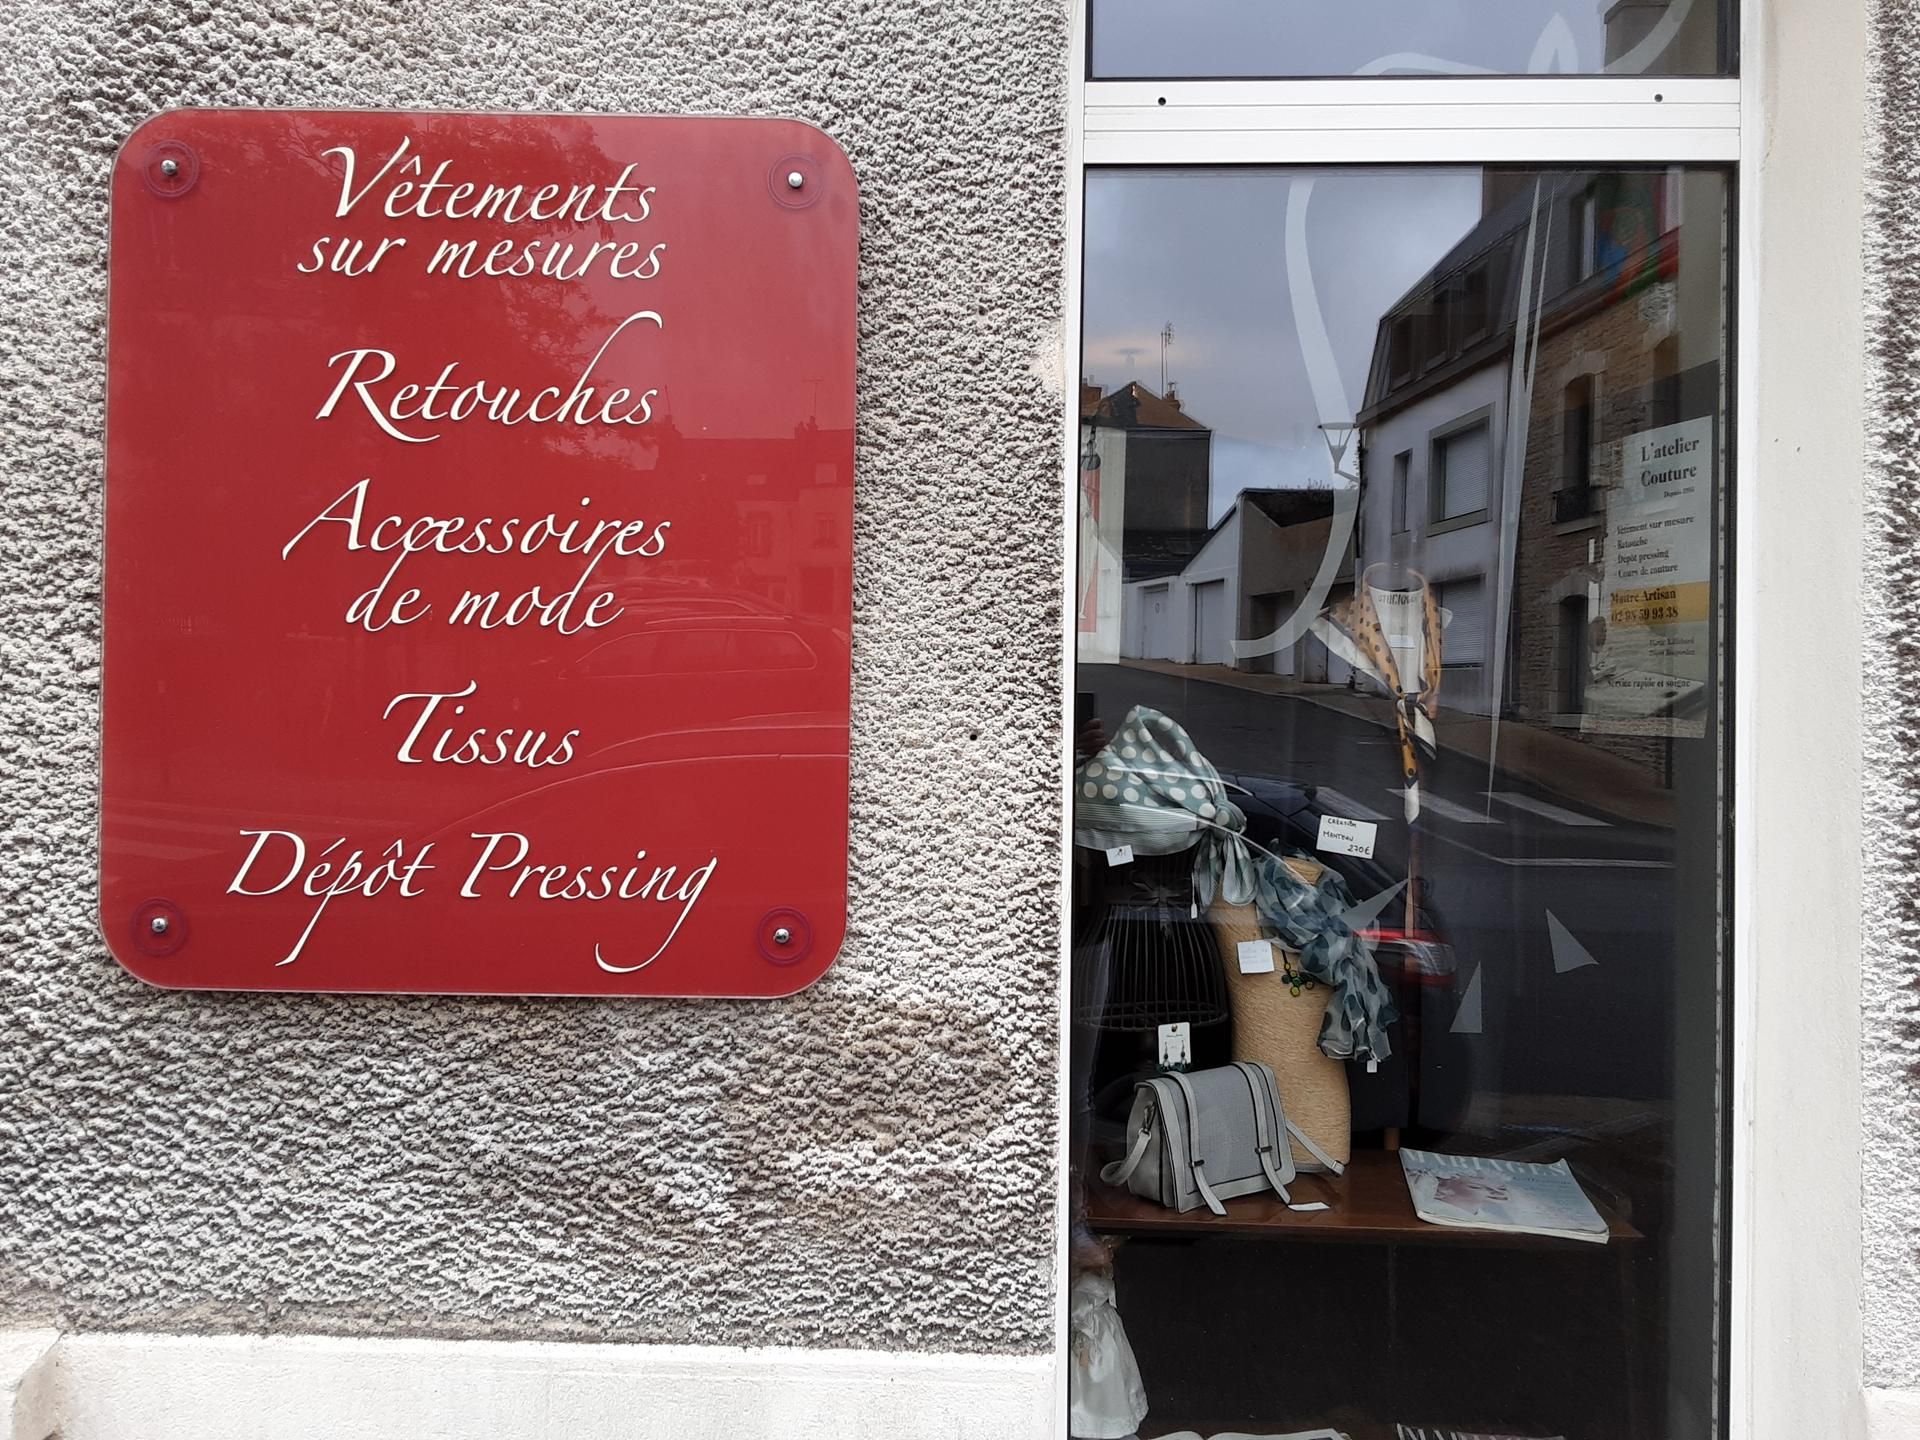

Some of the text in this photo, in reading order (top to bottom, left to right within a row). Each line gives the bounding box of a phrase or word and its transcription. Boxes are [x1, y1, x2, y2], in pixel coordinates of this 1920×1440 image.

[320, 136, 657, 224] Vêtements
[297, 238, 667, 280] sur mesures
[315, 310, 664, 444] Retouches
[1641, 437, 1700, 462] L'atelier
[1641, 465, 1697, 487] Couture
[282, 478, 671, 560] Accessoires
[1649, 521, 1662, 530] sur
[1664, 516, 1694, 528] mesure
[1617, 537, 1648, 550] Retouche
[1639, 548, 1670, 564] pressing
[345, 520, 629, 636] de mode
[1618, 564, 1679, 579] Cours de couture
[1643, 588, 1677, 602] Artisan
[1639, 609, 1650, 621] 59
[1651, 607, 1665, 620] 93
[1665, 606, 1679, 619] 38
[1608, 678, 1632, 688] Service
[1656, 679, 1665, 688] et
[383, 680, 580, 765] Tissus
[1347, 843, 1371, 856] 270€
[226, 828, 718, 973] Dépôt Pressing
